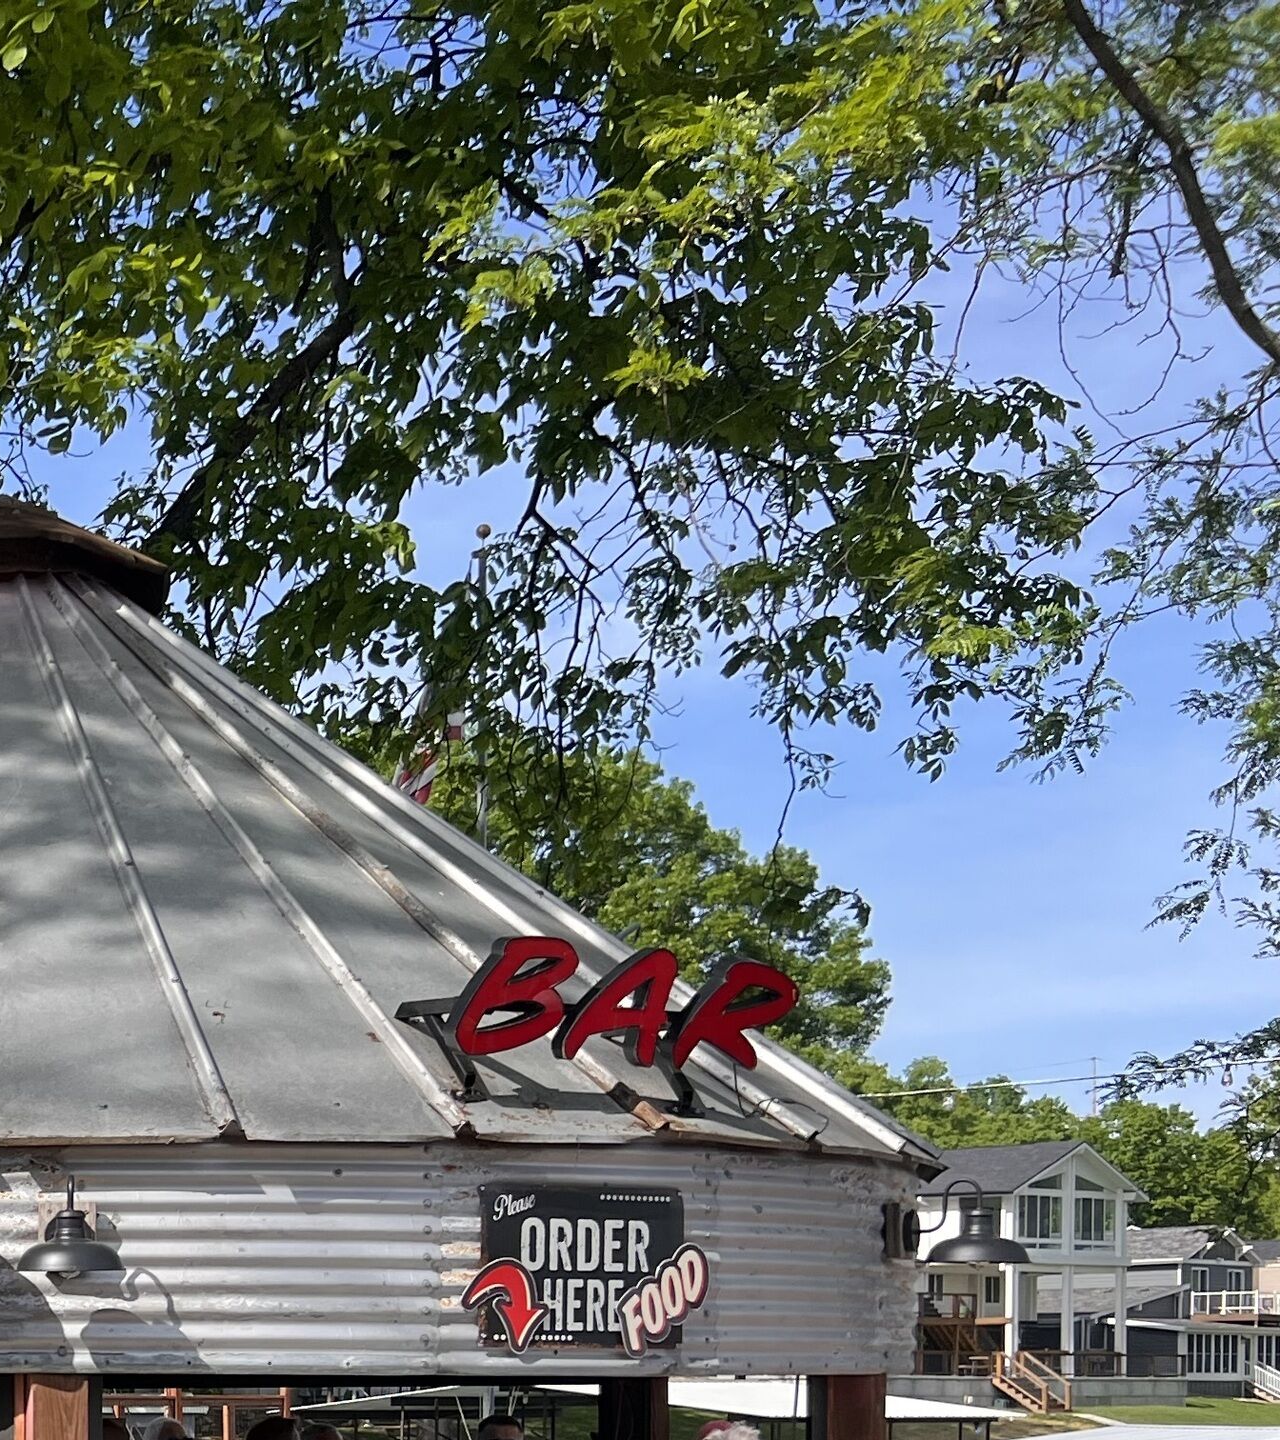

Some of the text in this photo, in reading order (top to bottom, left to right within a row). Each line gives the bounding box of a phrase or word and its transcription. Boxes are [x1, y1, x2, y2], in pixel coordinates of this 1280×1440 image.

[453, 936, 799, 1069] BAR
[492, 1193, 536, 1221] Please
[520, 1217, 650, 1273] ORDER
[541, 1278, 626, 1332] HERE
[622, 1249, 707, 1351] FOOD
